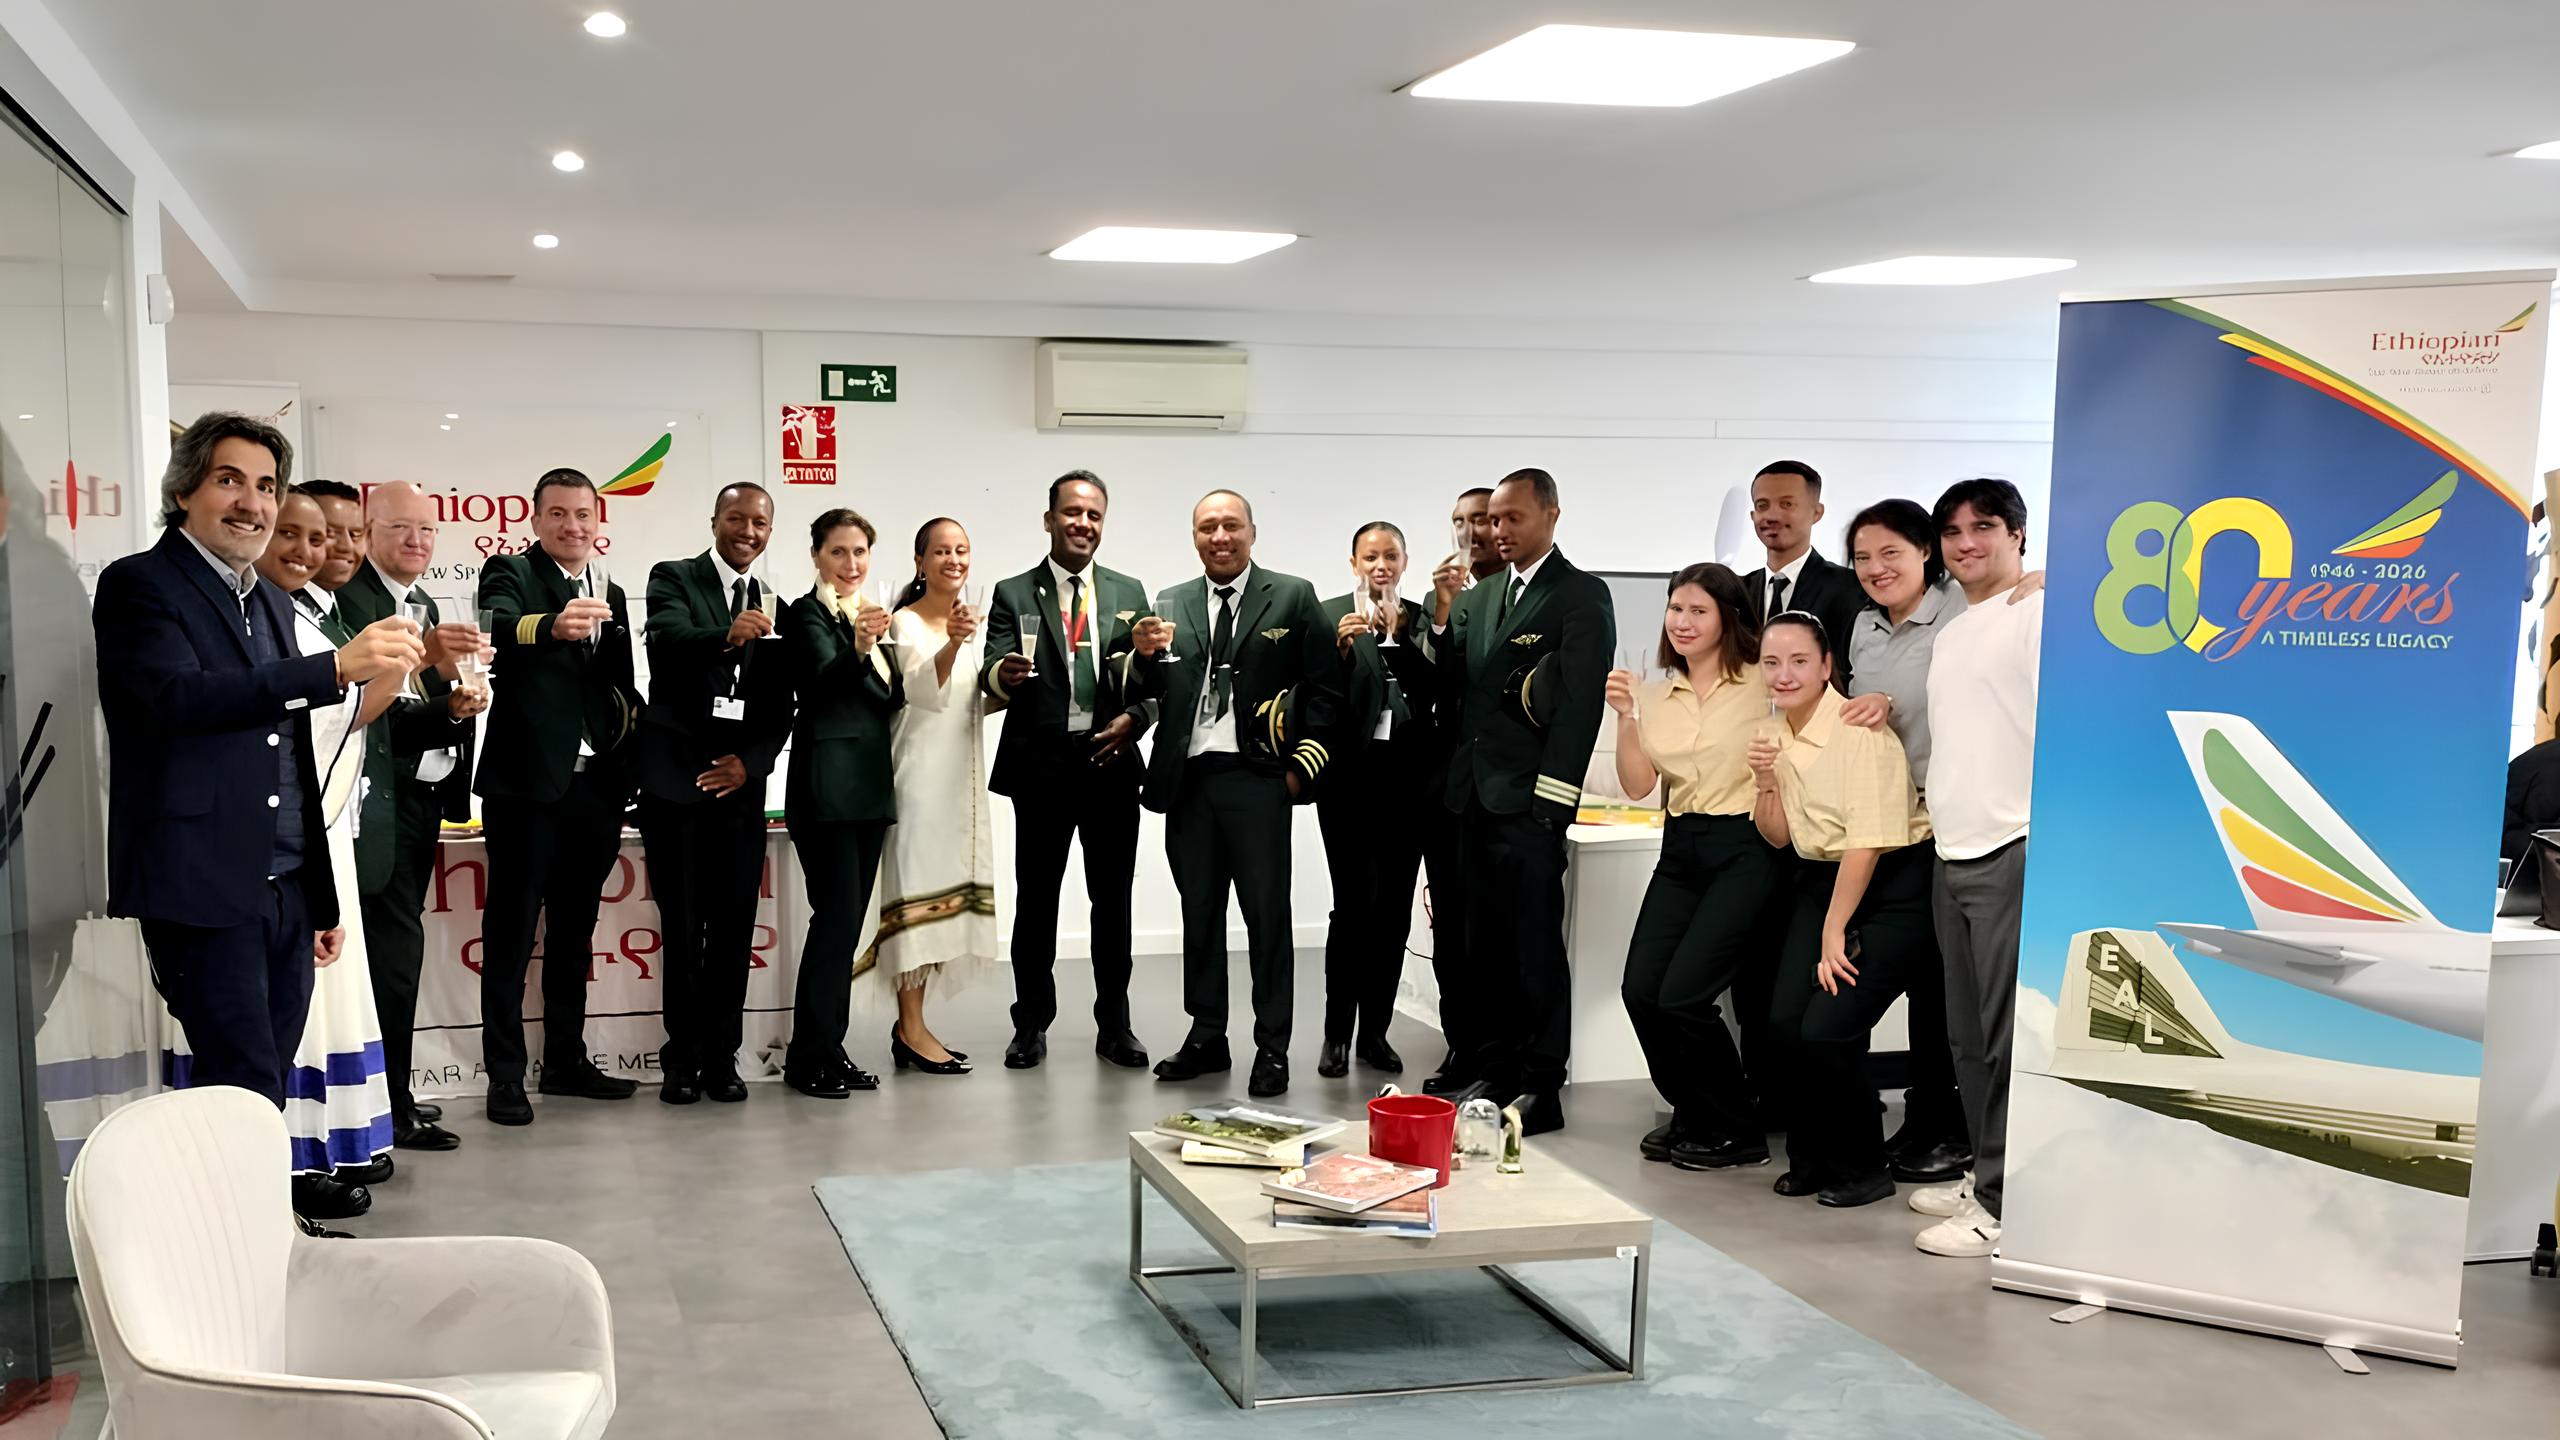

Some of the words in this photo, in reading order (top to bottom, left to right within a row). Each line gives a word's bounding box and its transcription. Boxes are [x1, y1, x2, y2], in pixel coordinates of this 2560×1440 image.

[2092, 496, 2294, 655] 80
[2203, 572, 2461, 663] years
[2374, 563, 2427, 580] 2026
[410, 1064, 462, 1089] TAR
